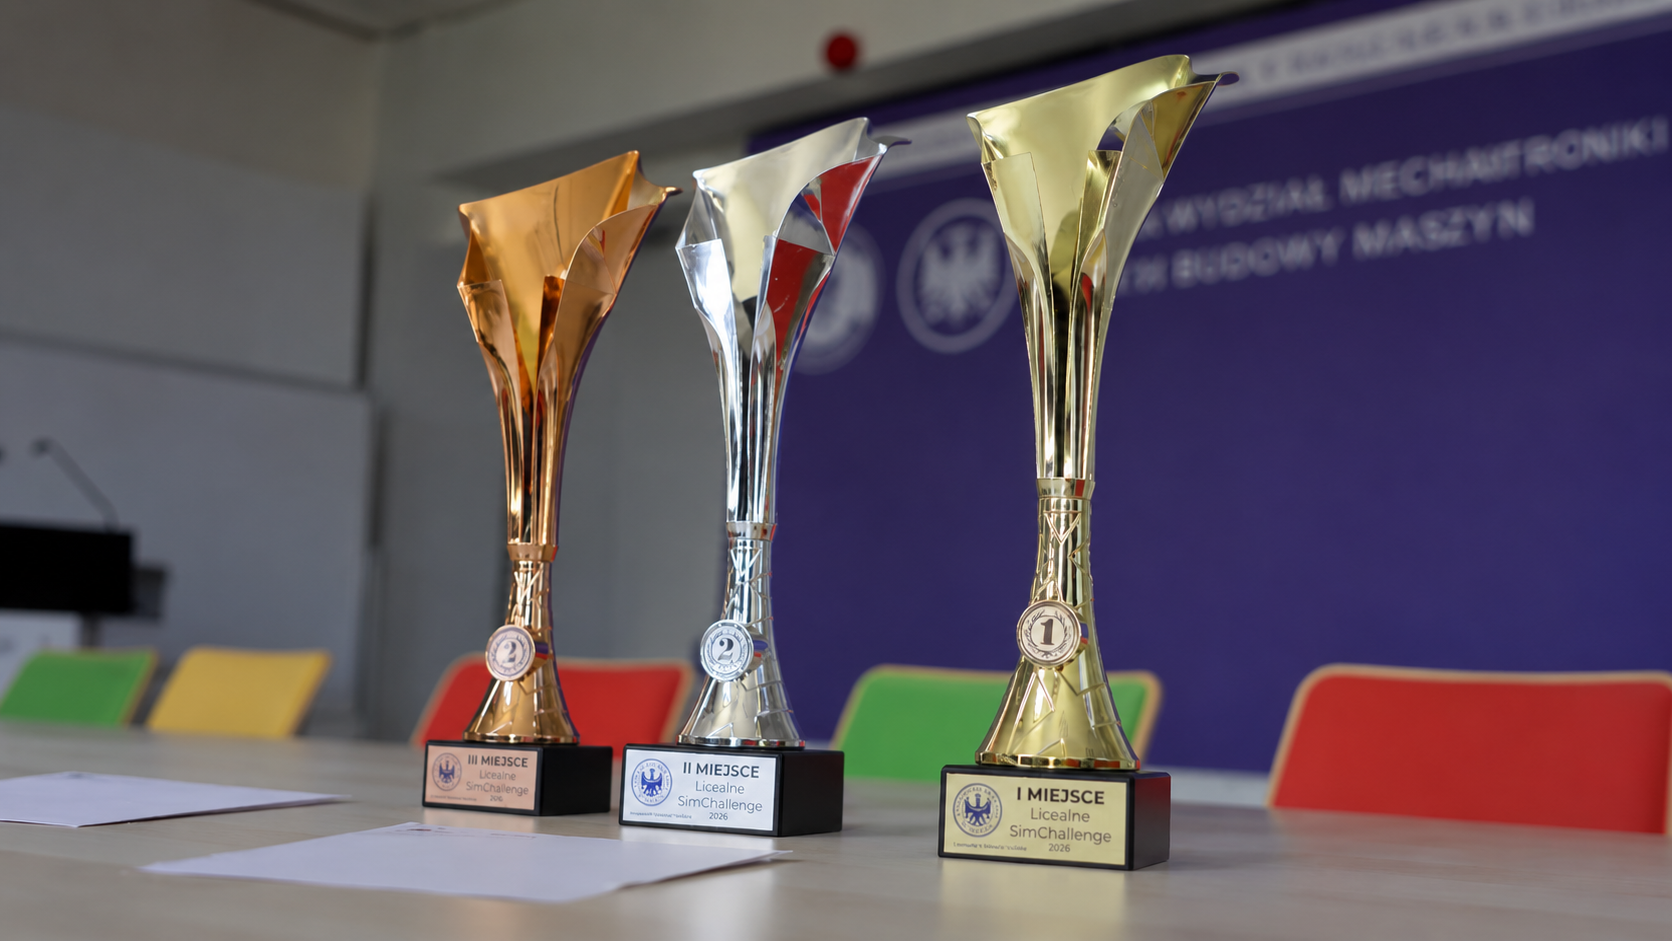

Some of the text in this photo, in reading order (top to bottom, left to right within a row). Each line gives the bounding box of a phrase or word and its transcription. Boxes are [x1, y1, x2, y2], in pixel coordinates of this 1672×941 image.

[1171, 226, 1346, 289] BUDOWY
[1353, 196, 1535, 260] MASZYN
[1040, 618, 1055, 646] 1
[503, 641, 517, 663] 2
[717, 638, 734, 663] 2
[467, 754, 528, 768] III MIEJSCE
[479, 770, 516, 781] Licealne
[683, 762, 760, 778] II MIEJSCE
[466, 782, 529, 796] SimChallenge
[695, 781, 745, 794] Licealne
[1017, 787, 1105, 805] I MIEJSCE
[677, 796, 763, 814] SimChallenge
[708, 812, 728, 821] 2026
[1030, 807, 1090, 823] Licealne
[1009, 825, 1112, 845] SimChallenge
[1048, 843, 1071, 853] 2026
